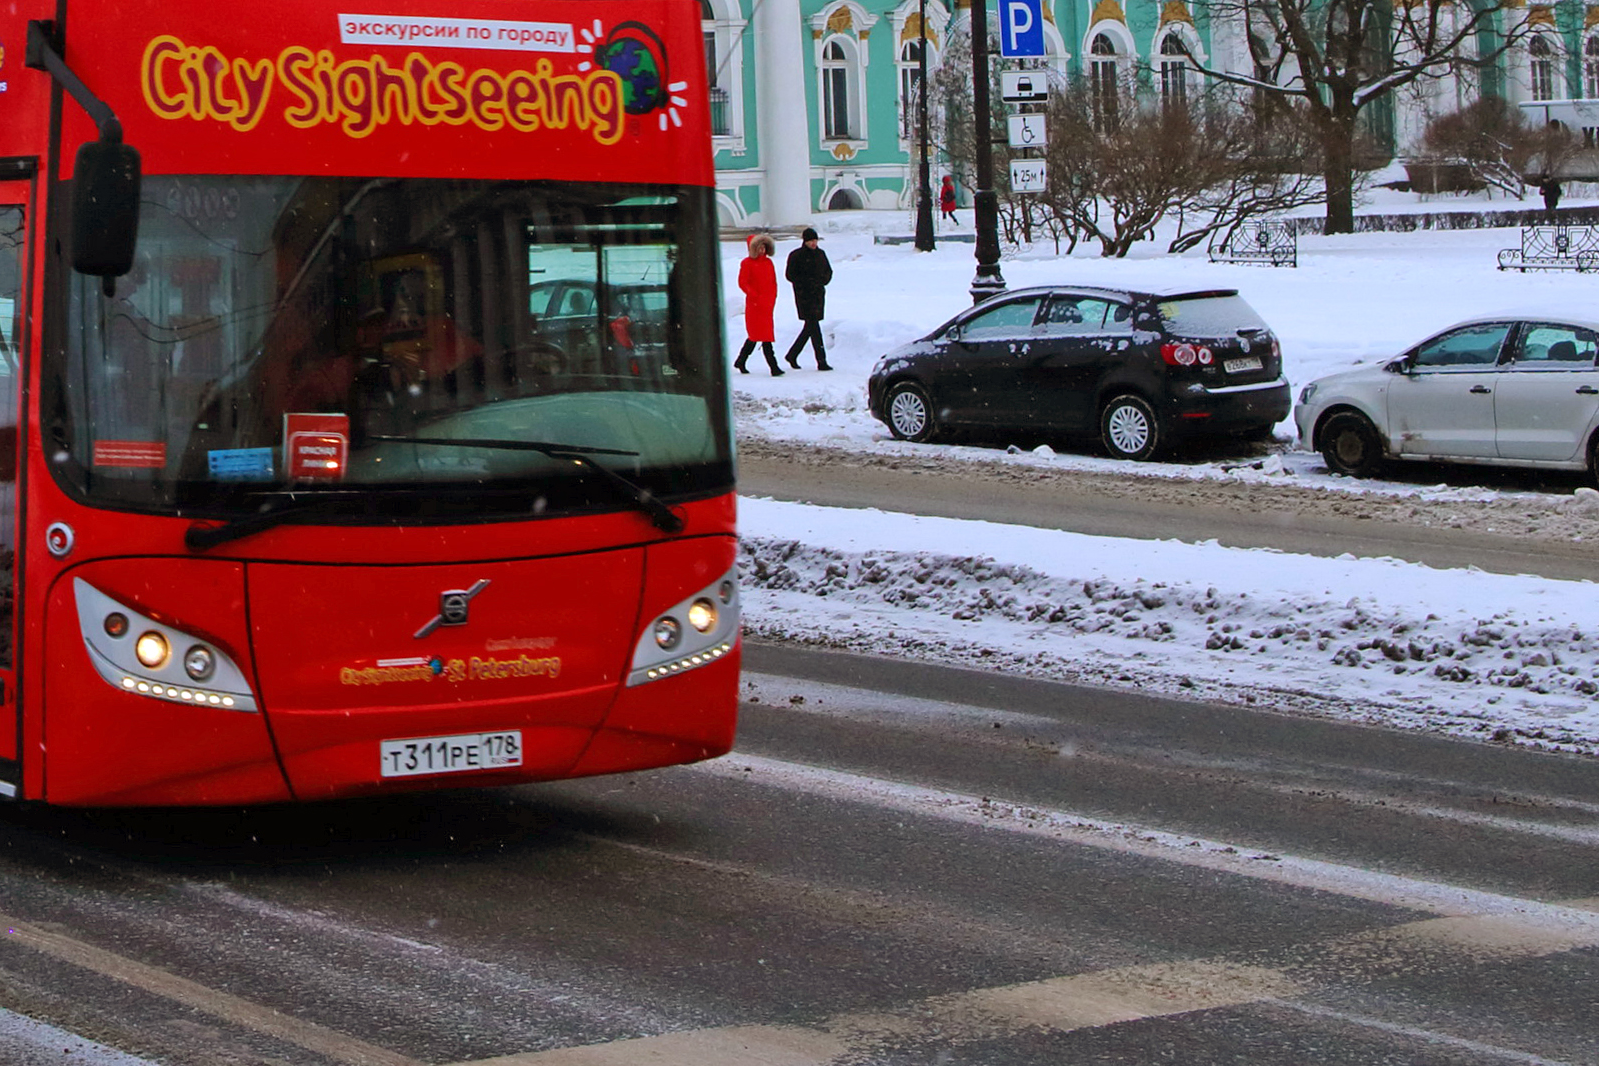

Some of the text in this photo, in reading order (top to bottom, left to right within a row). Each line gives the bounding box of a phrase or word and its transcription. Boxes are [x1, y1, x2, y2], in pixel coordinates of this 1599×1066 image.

[345, 19, 569, 47] экскурсии по городу
[1008, 2, 1033, 50] P
[469, 655, 562, 681] Petersburg
